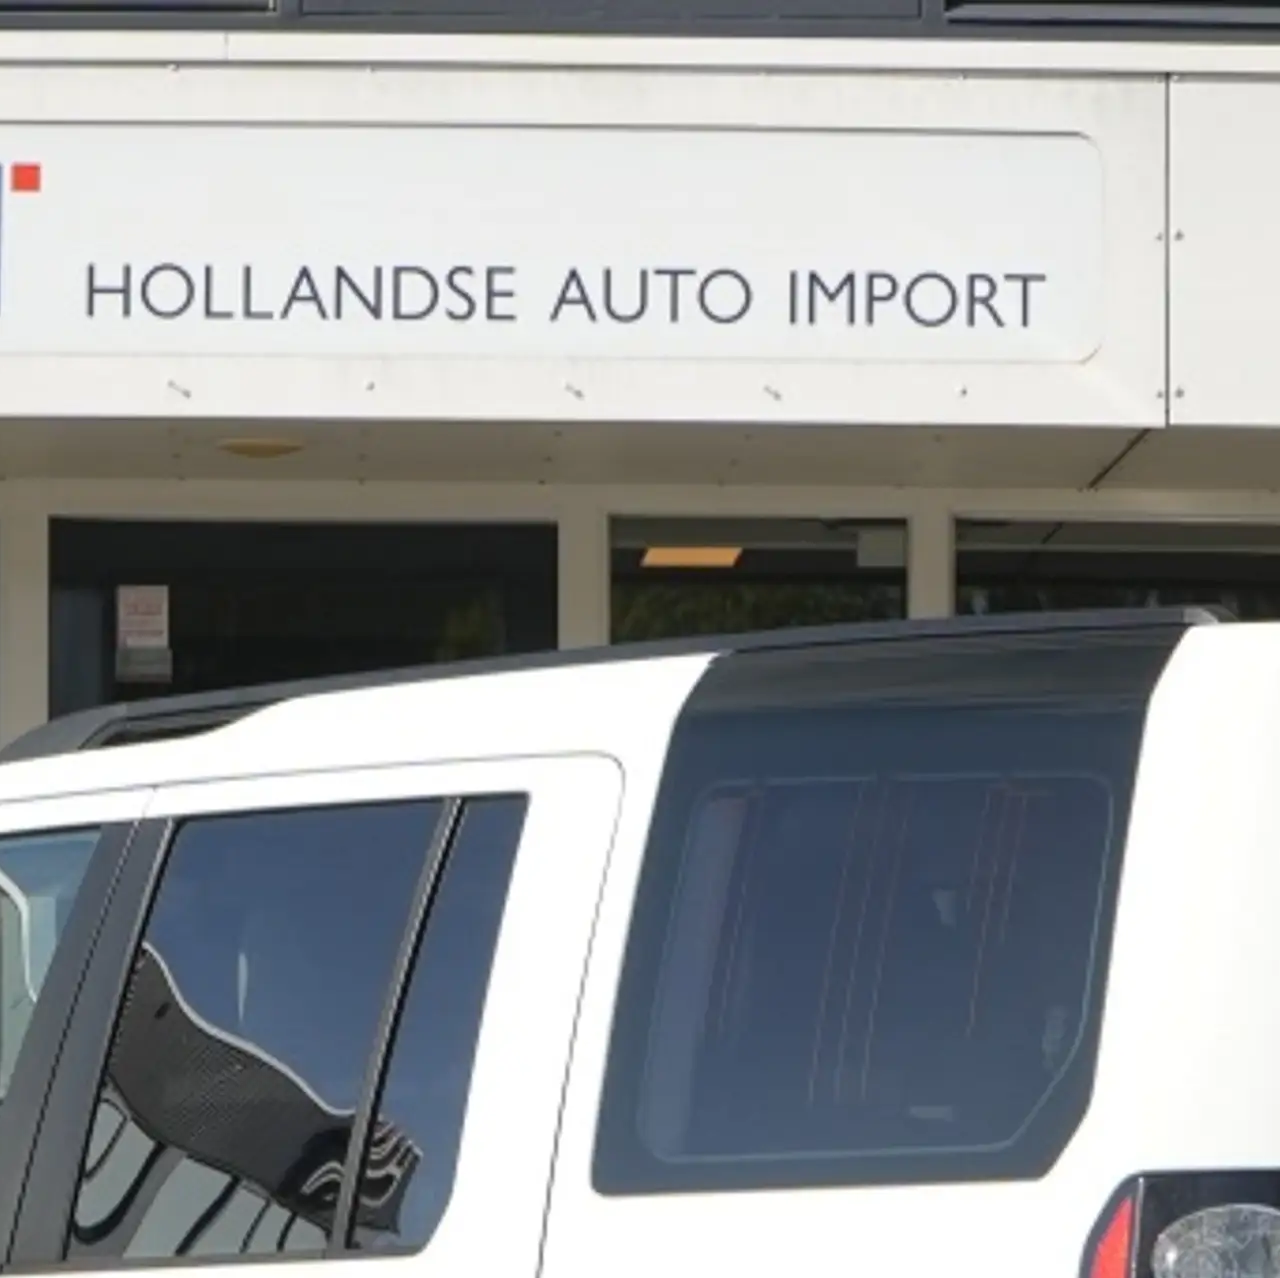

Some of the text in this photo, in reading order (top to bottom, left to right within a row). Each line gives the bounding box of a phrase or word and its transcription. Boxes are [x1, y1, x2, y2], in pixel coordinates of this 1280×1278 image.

[87, 263, 1046, 328] HOLLANDSE AUTO IMPORT
